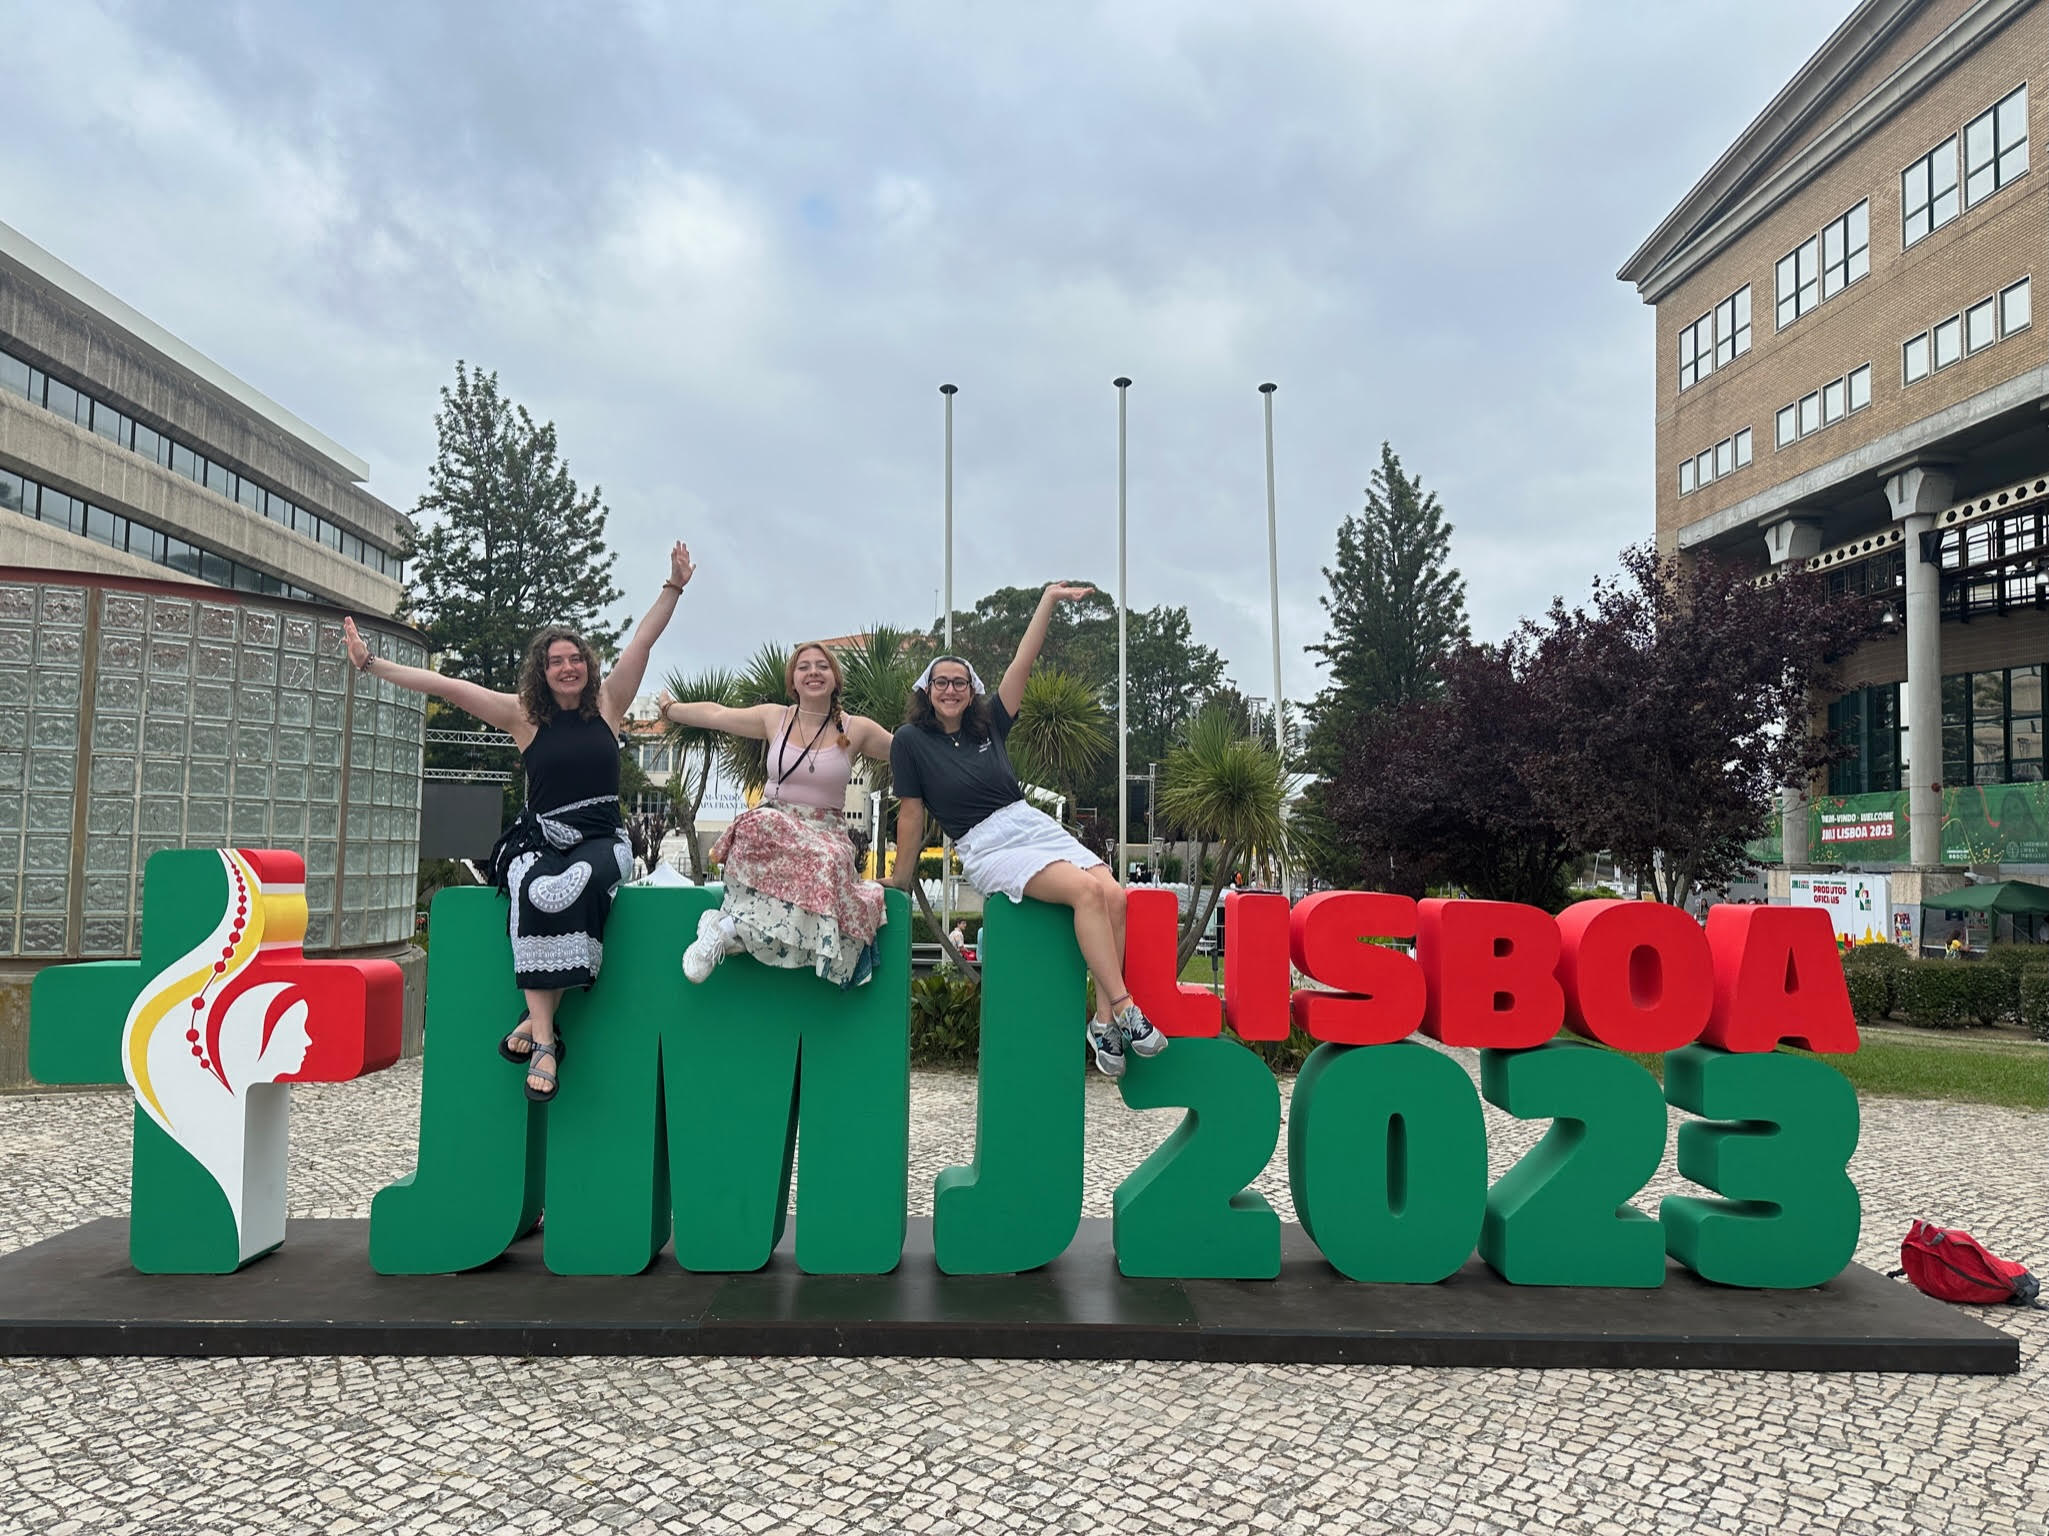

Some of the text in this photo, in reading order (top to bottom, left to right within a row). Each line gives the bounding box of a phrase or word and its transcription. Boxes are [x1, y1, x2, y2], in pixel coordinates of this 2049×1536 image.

[1821, 812, 1894, 823] BEM-VINDO WELCOME
[1822, 824, 1893, 840] JMJ LISBOA 2023
[1813, 885, 1847, 895] PRODUTOS
[1123, 889, 1861, 1055] LISBOA
[369, 884, 1087, 1276] JMJ
[1112, 1037, 1861, 1290] 2023
